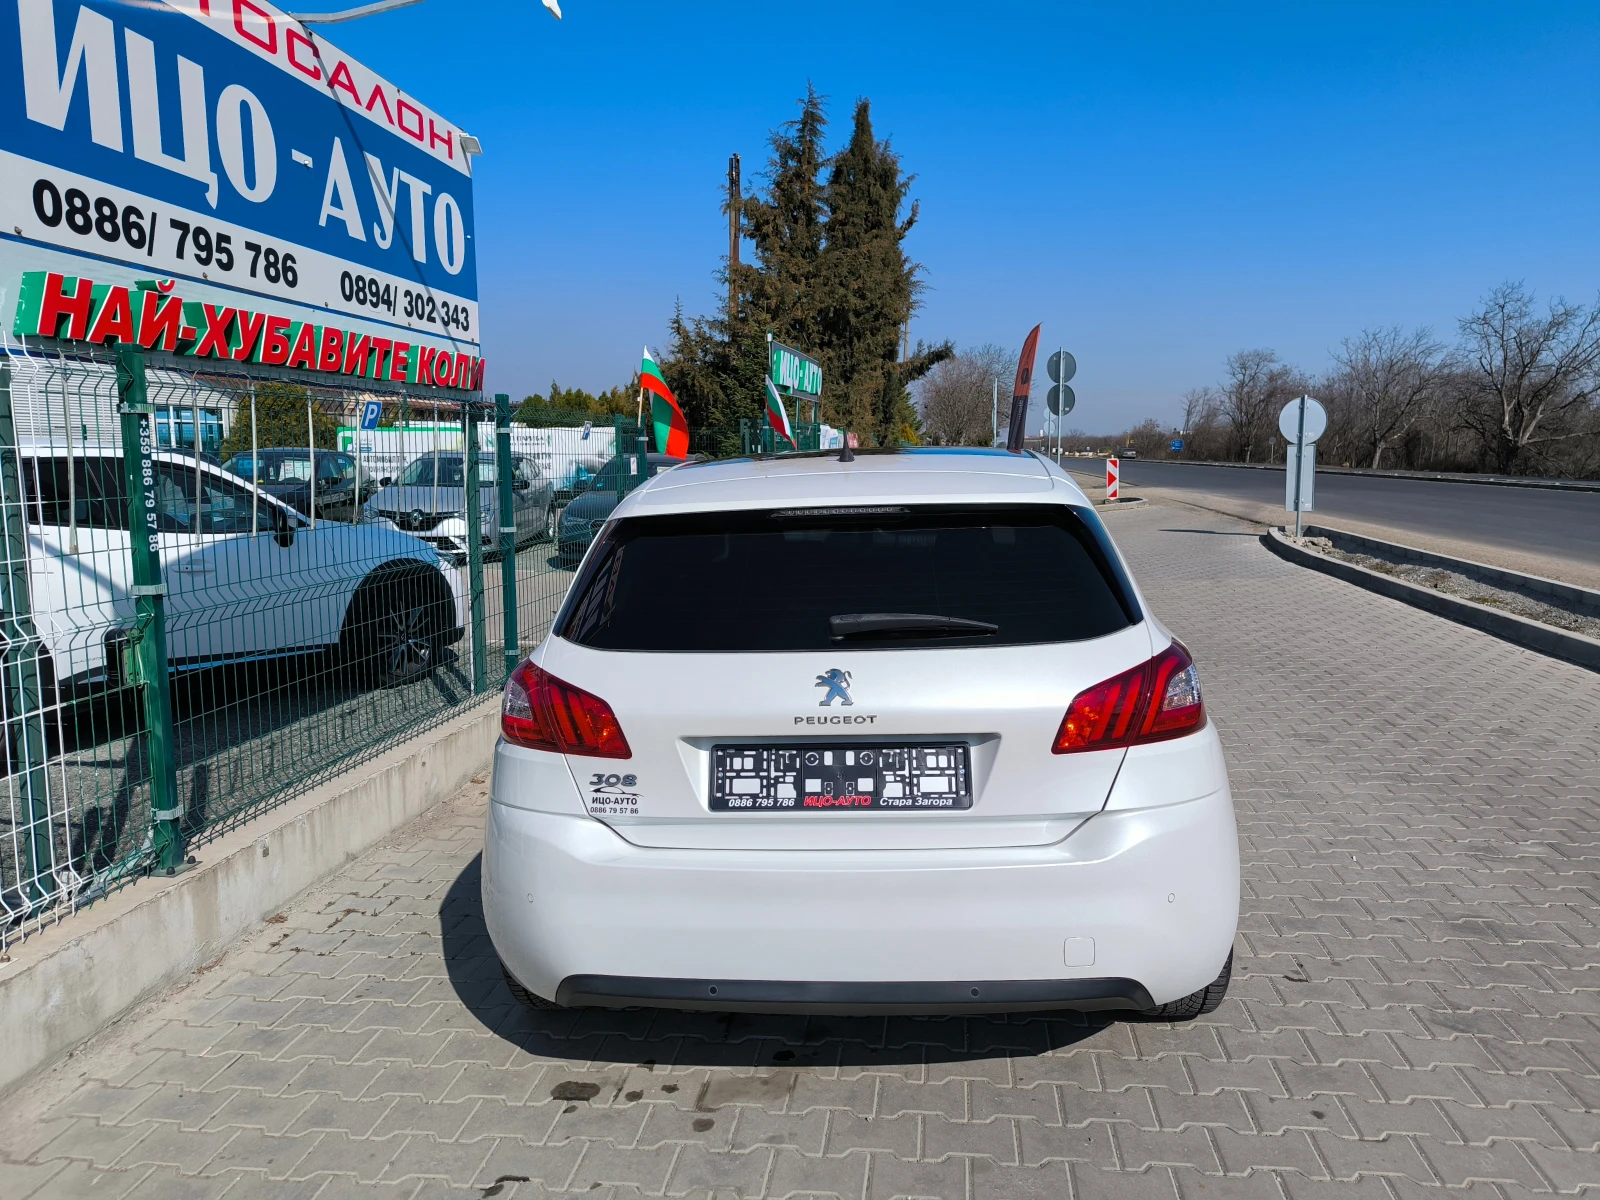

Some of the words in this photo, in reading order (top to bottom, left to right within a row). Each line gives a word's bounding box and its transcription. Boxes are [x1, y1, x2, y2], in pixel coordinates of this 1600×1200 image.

[199, 0, 454, 160] ОСАЛОН
[32, 178, 157, 256] 0886/
[169, 217, 234, 271] 795
[244, 241, 298, 288] 786
[340, 270, 398, 316] 0894/
[403, 290, 437, 323] 302
[441, 300, 470, 332] 343
[37, 272, 410, 382] НАЙ-ХУБАВИТЕ
[416, 344, 486, 391] КОЛИ
[364, 404, 378, 427] P
[139, 418, 151, 455] +359
[141, 459, 154, 486] 886
[144, 490, 156, 508] 79
[146, 513, 158, 530] 57
[148, 534, 160, 552] 86
[793, 714, 878, 726] PEUGEOT
[588, 773, 638, 788] 308
[591, 796, 638, 806] ИЦО-АУТО
[728, 798, 753, 807] 0886
[755, 798, 774, 807] 795
[776, 798, 795, 807] 786
[803, 795, 872, 808] ИЦО-АУТО
[879, 797, 912, 808] Стара
[914, 797, 953, 808] Загора
[590, 806, 607, 814] 0886
[630, 807, 639, 815] 86
